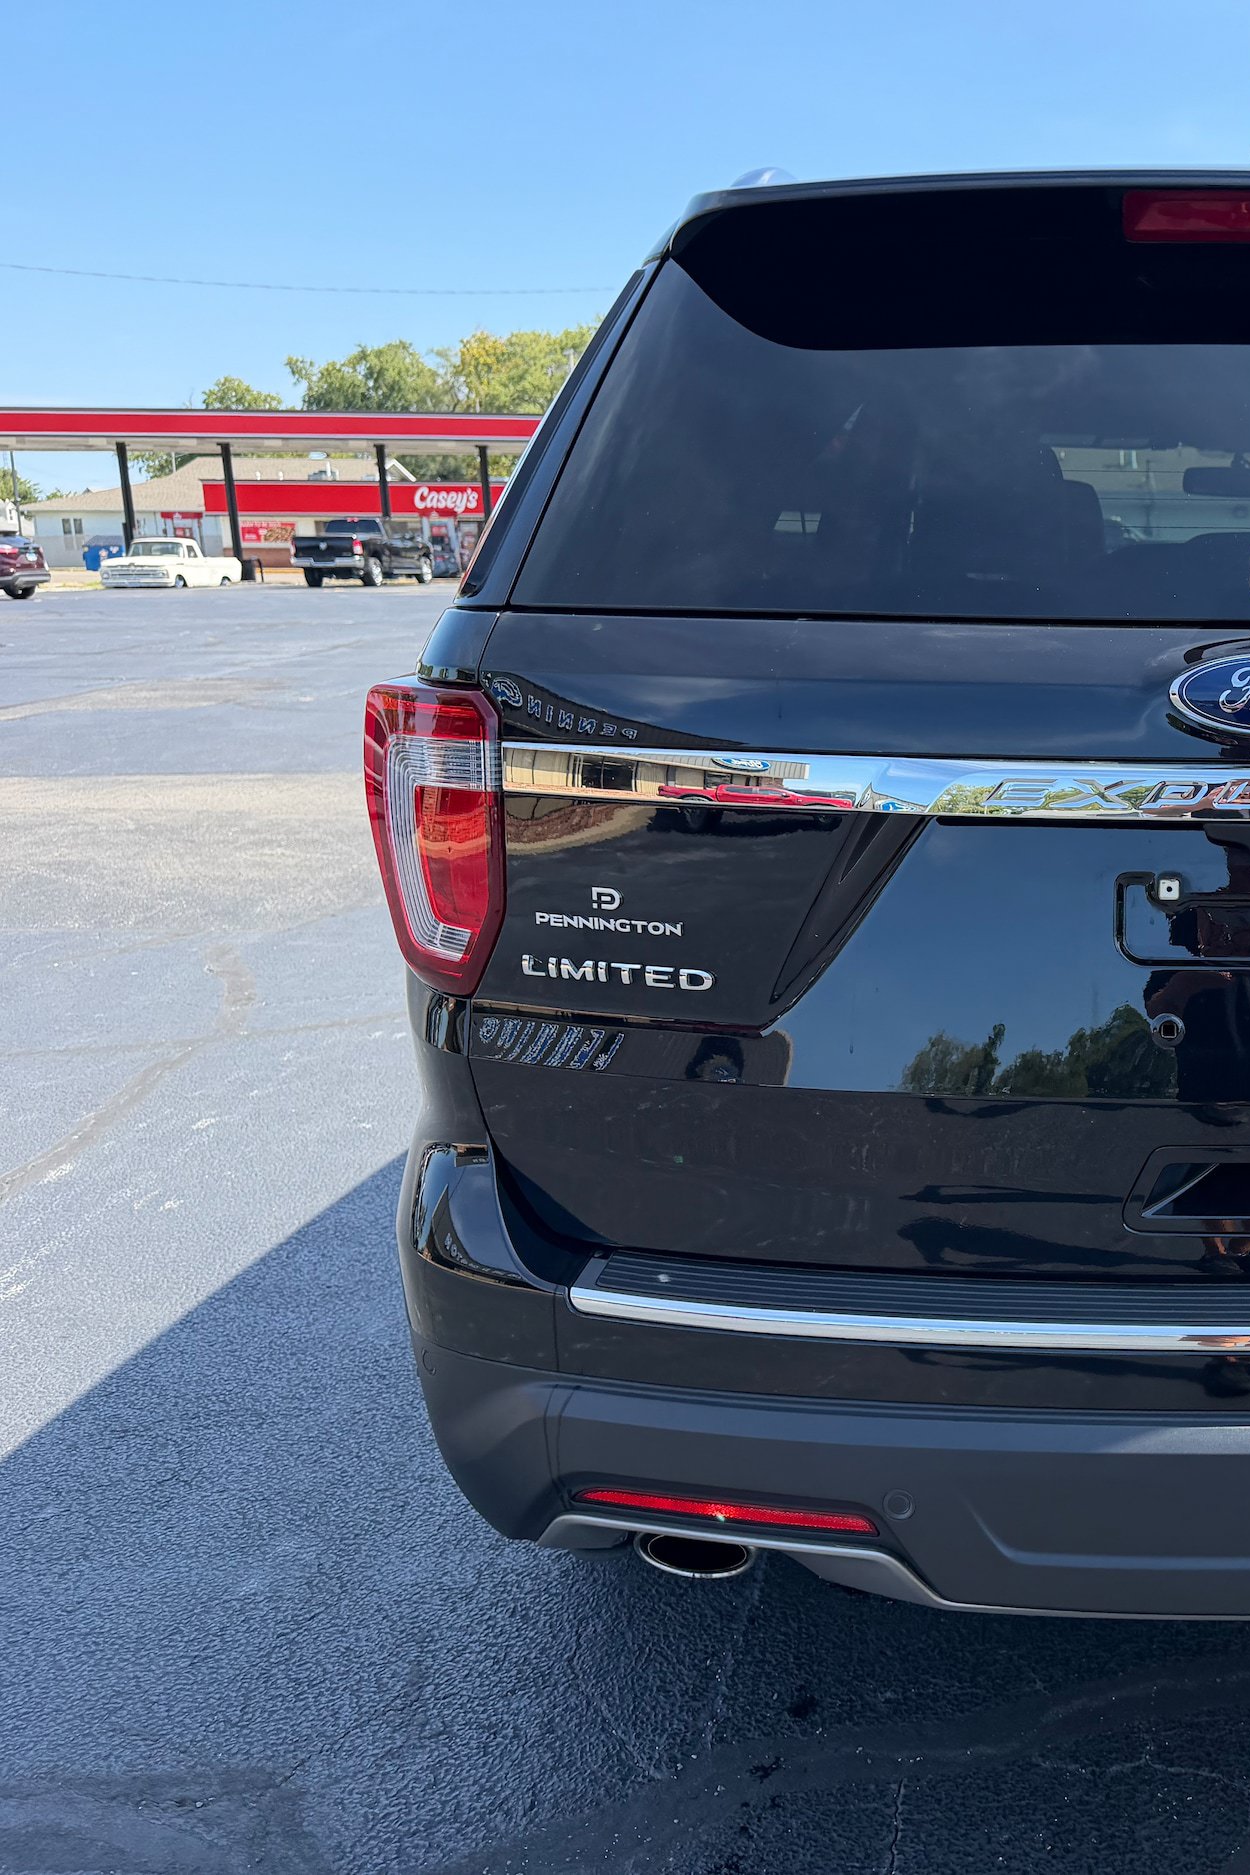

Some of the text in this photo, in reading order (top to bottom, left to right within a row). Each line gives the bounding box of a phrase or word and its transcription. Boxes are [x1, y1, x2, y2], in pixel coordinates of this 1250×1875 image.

[414, 486, 479, 514] Casey's
[535, 911, 683, 937] PENNINGTON
[522, 954, 714, 991] LIMITED
